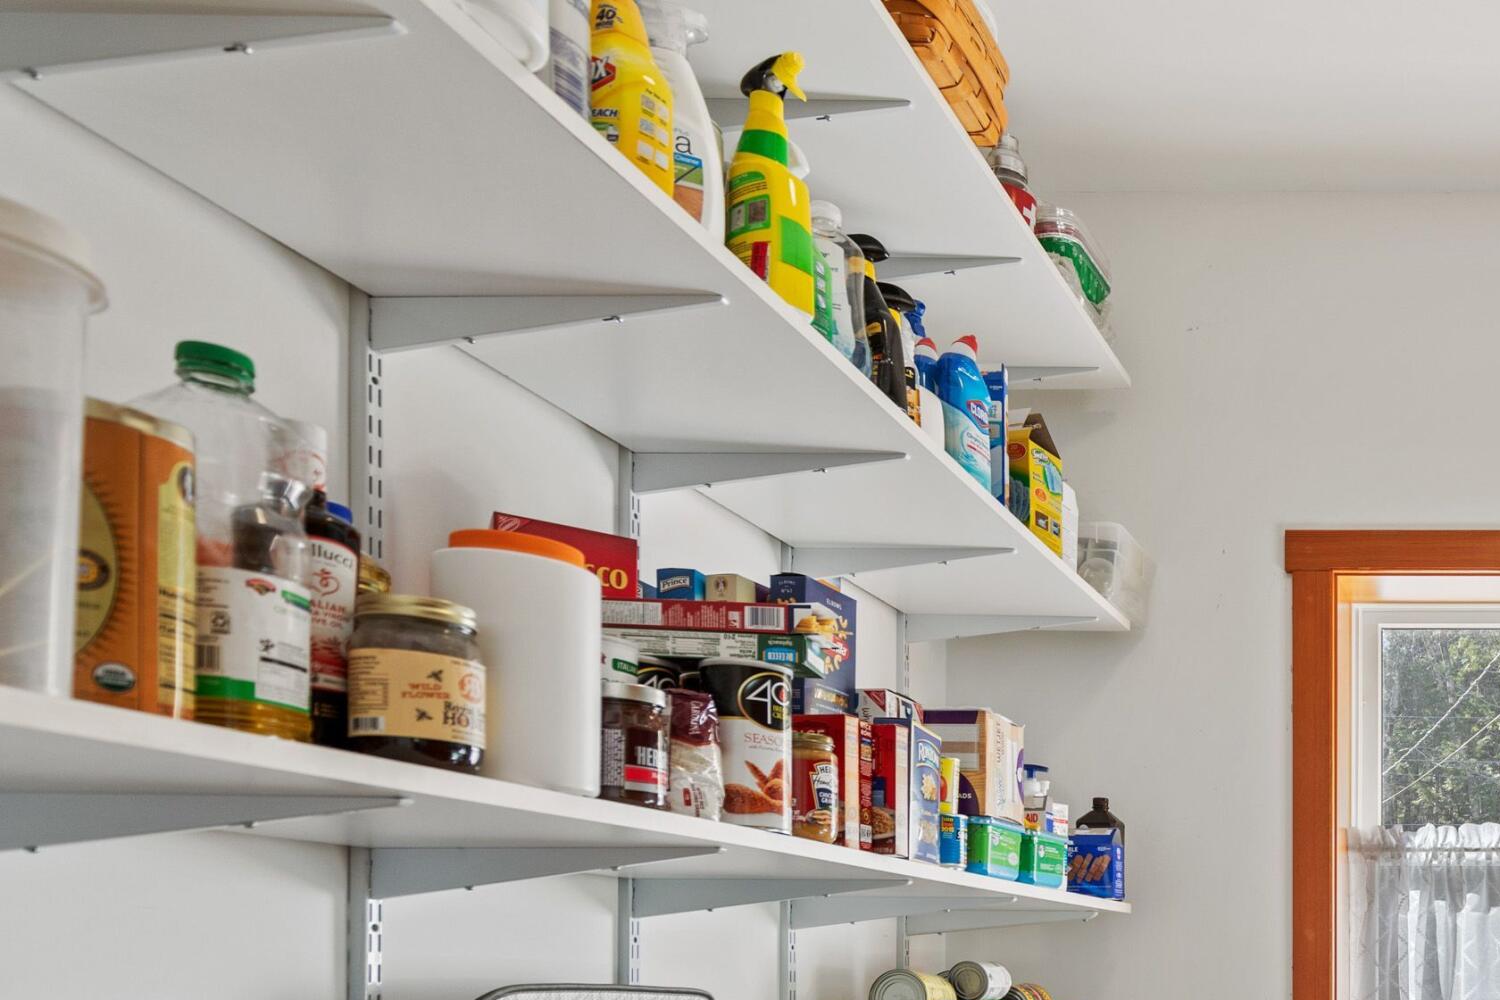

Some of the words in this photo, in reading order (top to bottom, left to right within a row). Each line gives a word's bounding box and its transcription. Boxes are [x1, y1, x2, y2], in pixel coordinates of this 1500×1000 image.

[596, 8, 617, 21] 40
[661, 577, 688, 590] Prince
[408, 682, 442, 690] WILD
[401, 691, 450, 700] FLOWER
[745, 679, 790, 725] 4C
[1026, 812, 1039, 824] AID
